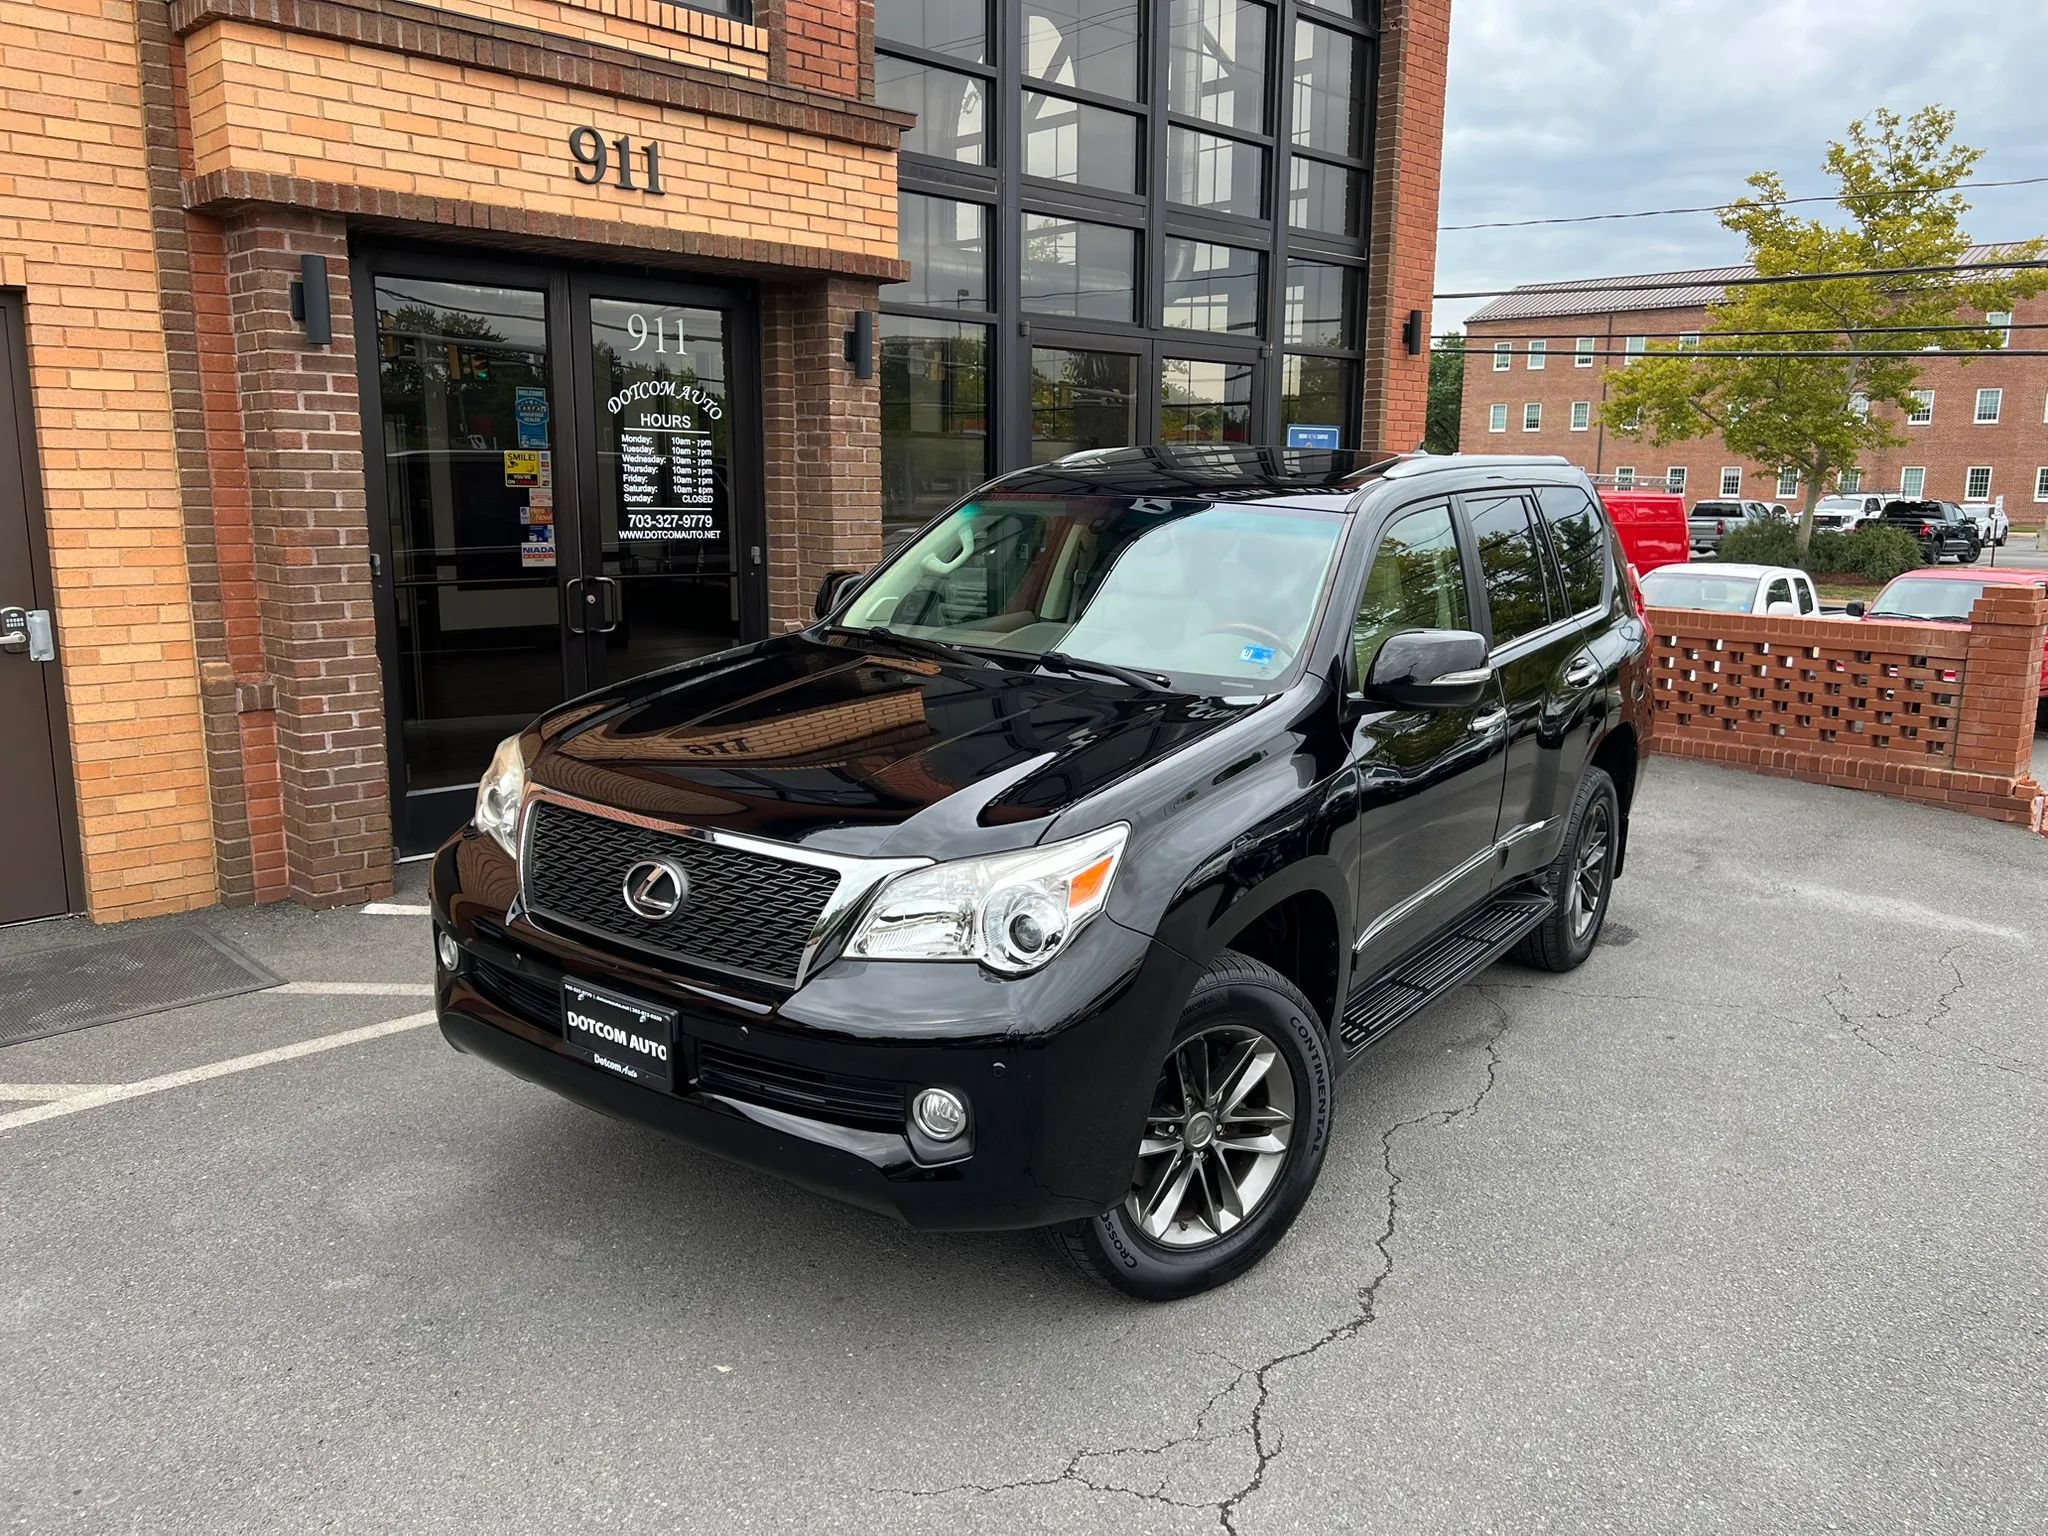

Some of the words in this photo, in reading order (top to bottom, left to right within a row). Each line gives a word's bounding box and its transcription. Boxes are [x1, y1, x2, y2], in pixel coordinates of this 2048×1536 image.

[569, 126, 666, 196] 911
[627, 313, 688, 355] 911
[607, 380, 676, 415] DOTCOM
[675, 385, 723, 420] AUTO
[640, 413, 692, 429] HOURS
[621, 434, 653, 445] Monday:
[671, 437, 691, 446] 10am
[621, 444, 655, 455] Tuesday:
[672, 447, 691, 455] 10am
[507, 453, 536, 462] SMILE!
[622, 454, 667, 465] Wednesday:
[672, 456, 692, 465] 10am
[622, 464, 658, 475] Thursday:
[672, 466, 692, 474] 10am
[622, 474, 648, 484] Friday:
[673, 475, 692, 484] 10am
[623, 484, 658, 494] Saturday:
[673, 485, 692, 494] 10am
[623, 494, 654, 504] Sunday:
[682, 495, 714, 503] CLOSED
[627, 514, 713, 528] 703-327-9779
[618, 530, 721, 539] WWW.DOTCOMAUTO.NET
[522, 546, 555, 554] NIADA
[567, 1010, 628, 1046] DOTCOM
[629, 1034, 667, 1061] AUTO
[593, 1053, 622, 1074] Dotcom
[620, 1065, 638, 1078] Auto
[1289, 1016, 1327, 1157] CONTINENTAL
